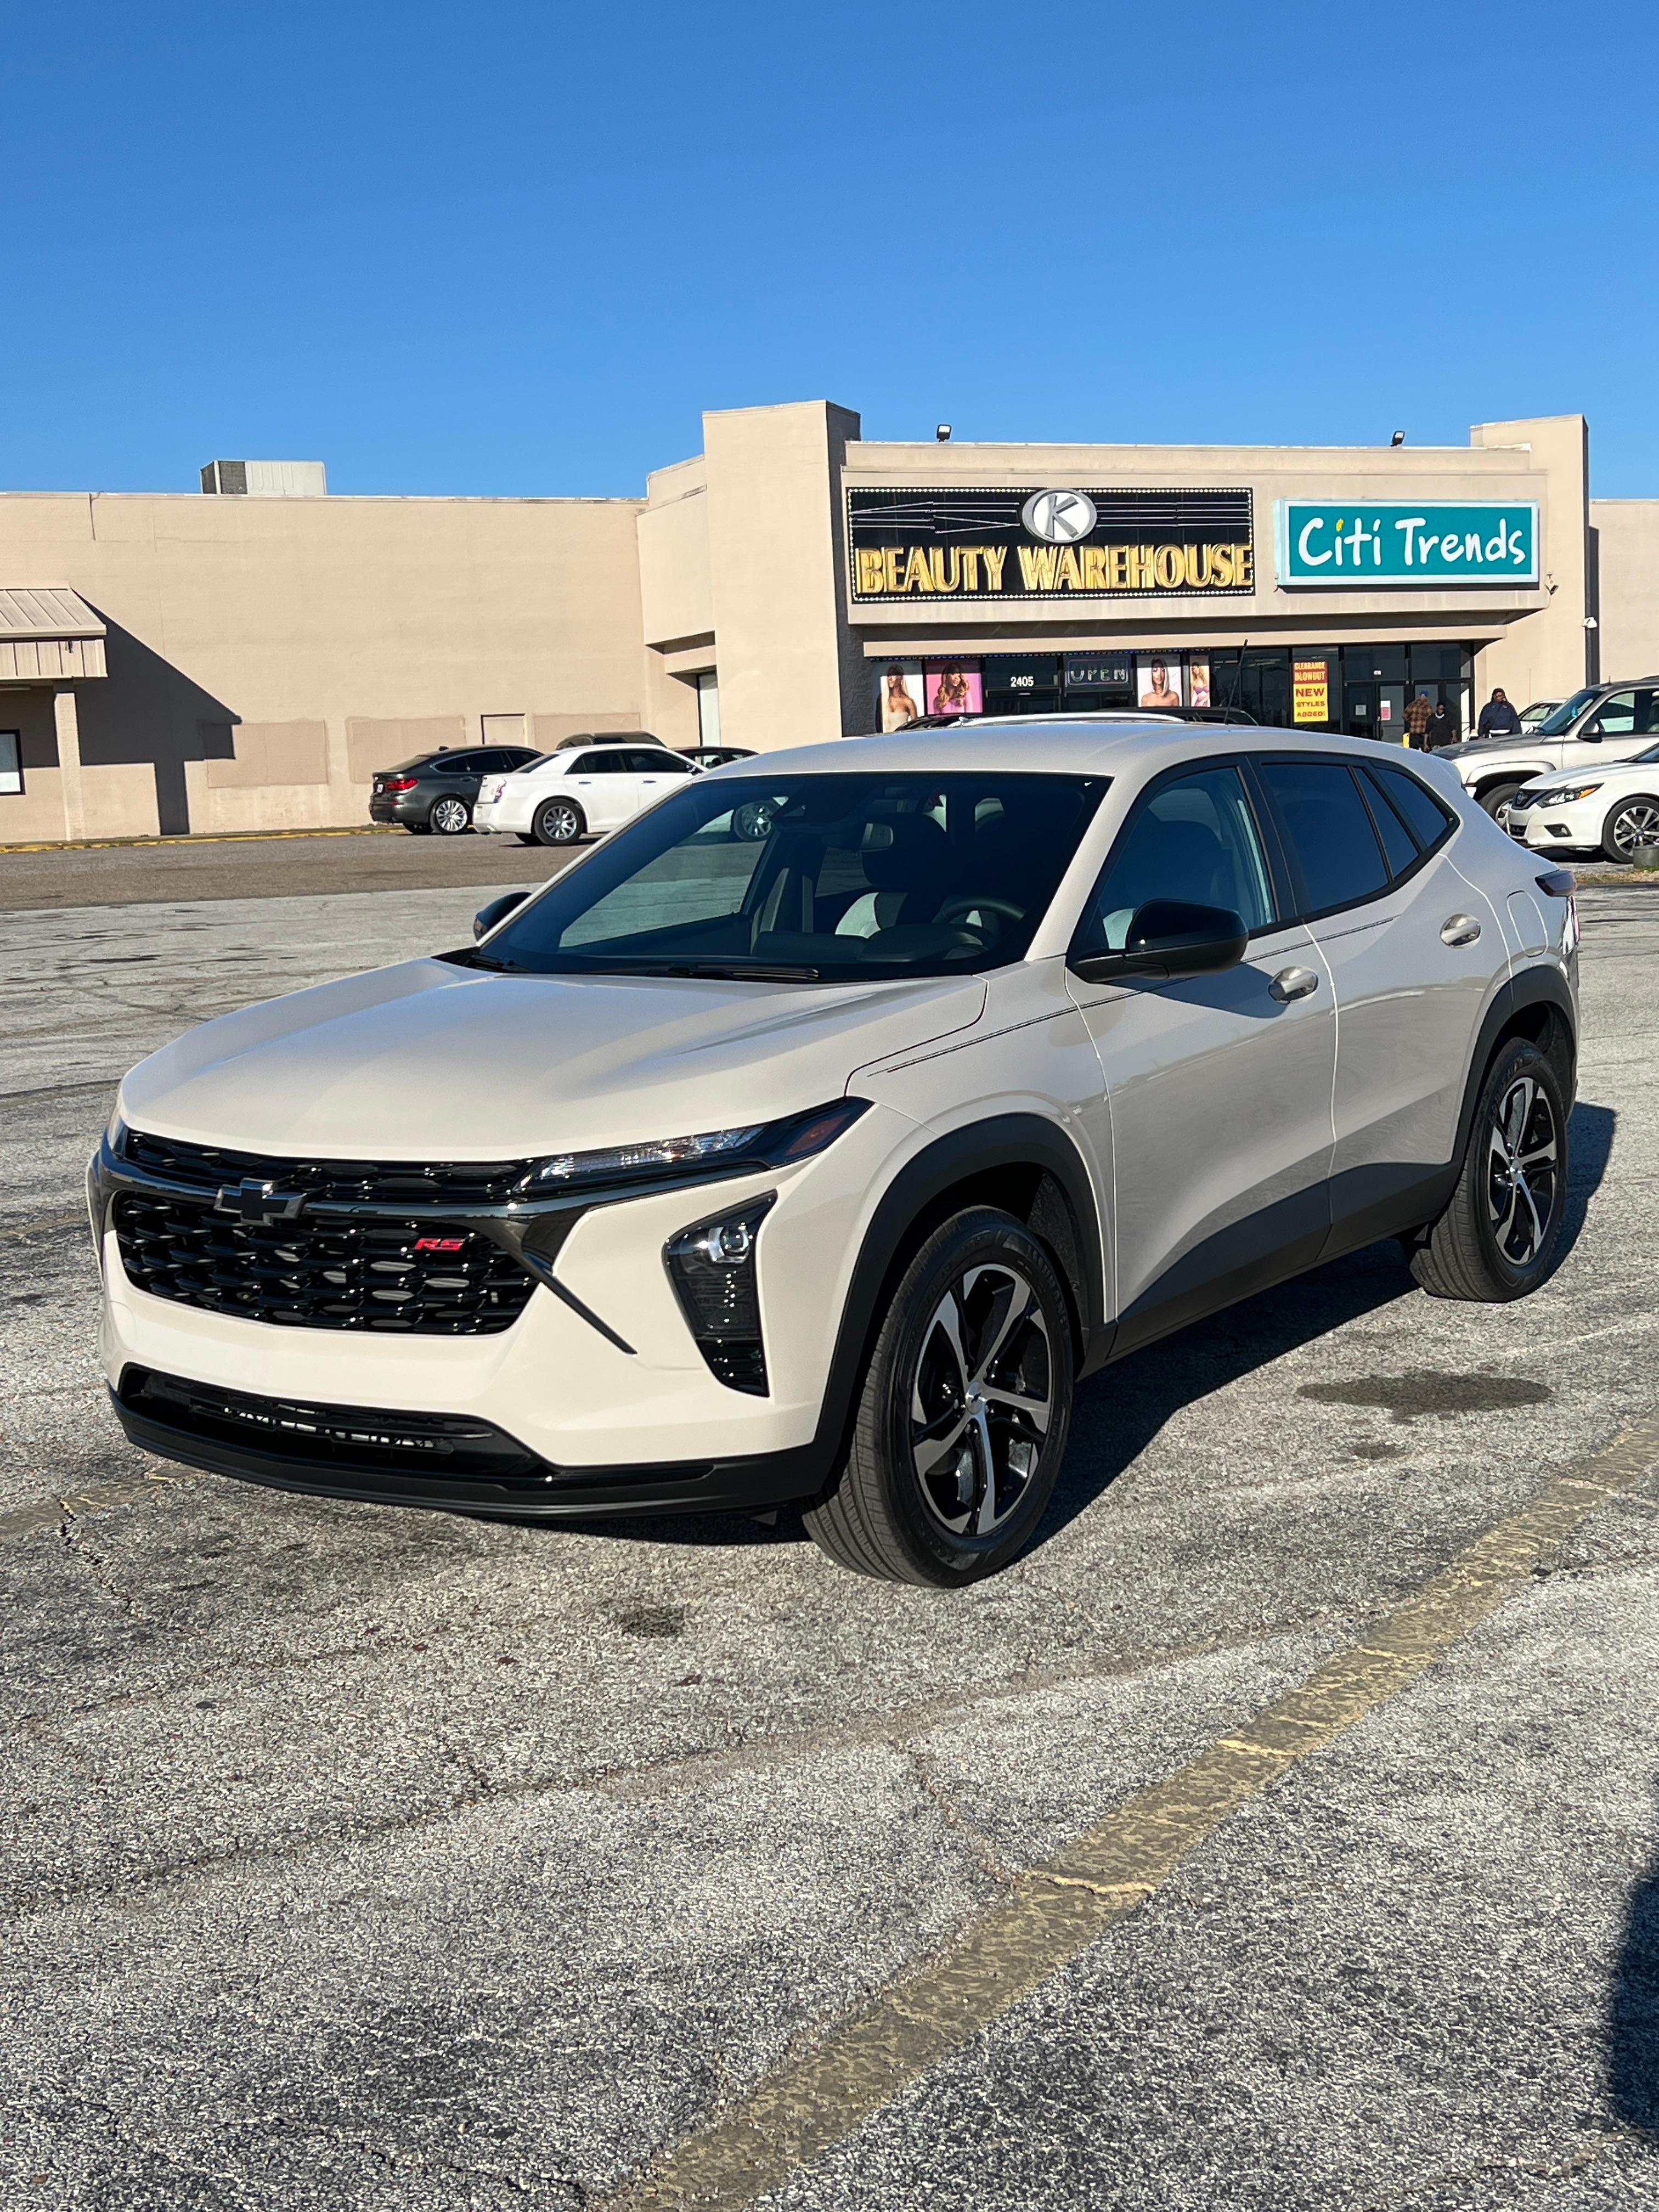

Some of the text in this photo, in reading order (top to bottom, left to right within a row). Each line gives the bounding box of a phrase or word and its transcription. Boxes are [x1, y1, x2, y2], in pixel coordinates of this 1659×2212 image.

[1045, 493, 1080, 540] K
[1299, 517, 1526, 566] Citi Trends
[855, 544, 1252, 594] BEAUTY WAREHOUSE
[1010, 676, 1034, 687] 2405
[1295, 672, 1325, 681] BLOWOUT
[1296, 687, 1325, 697] NEW
[415, 1238, 464, 1250] RS
